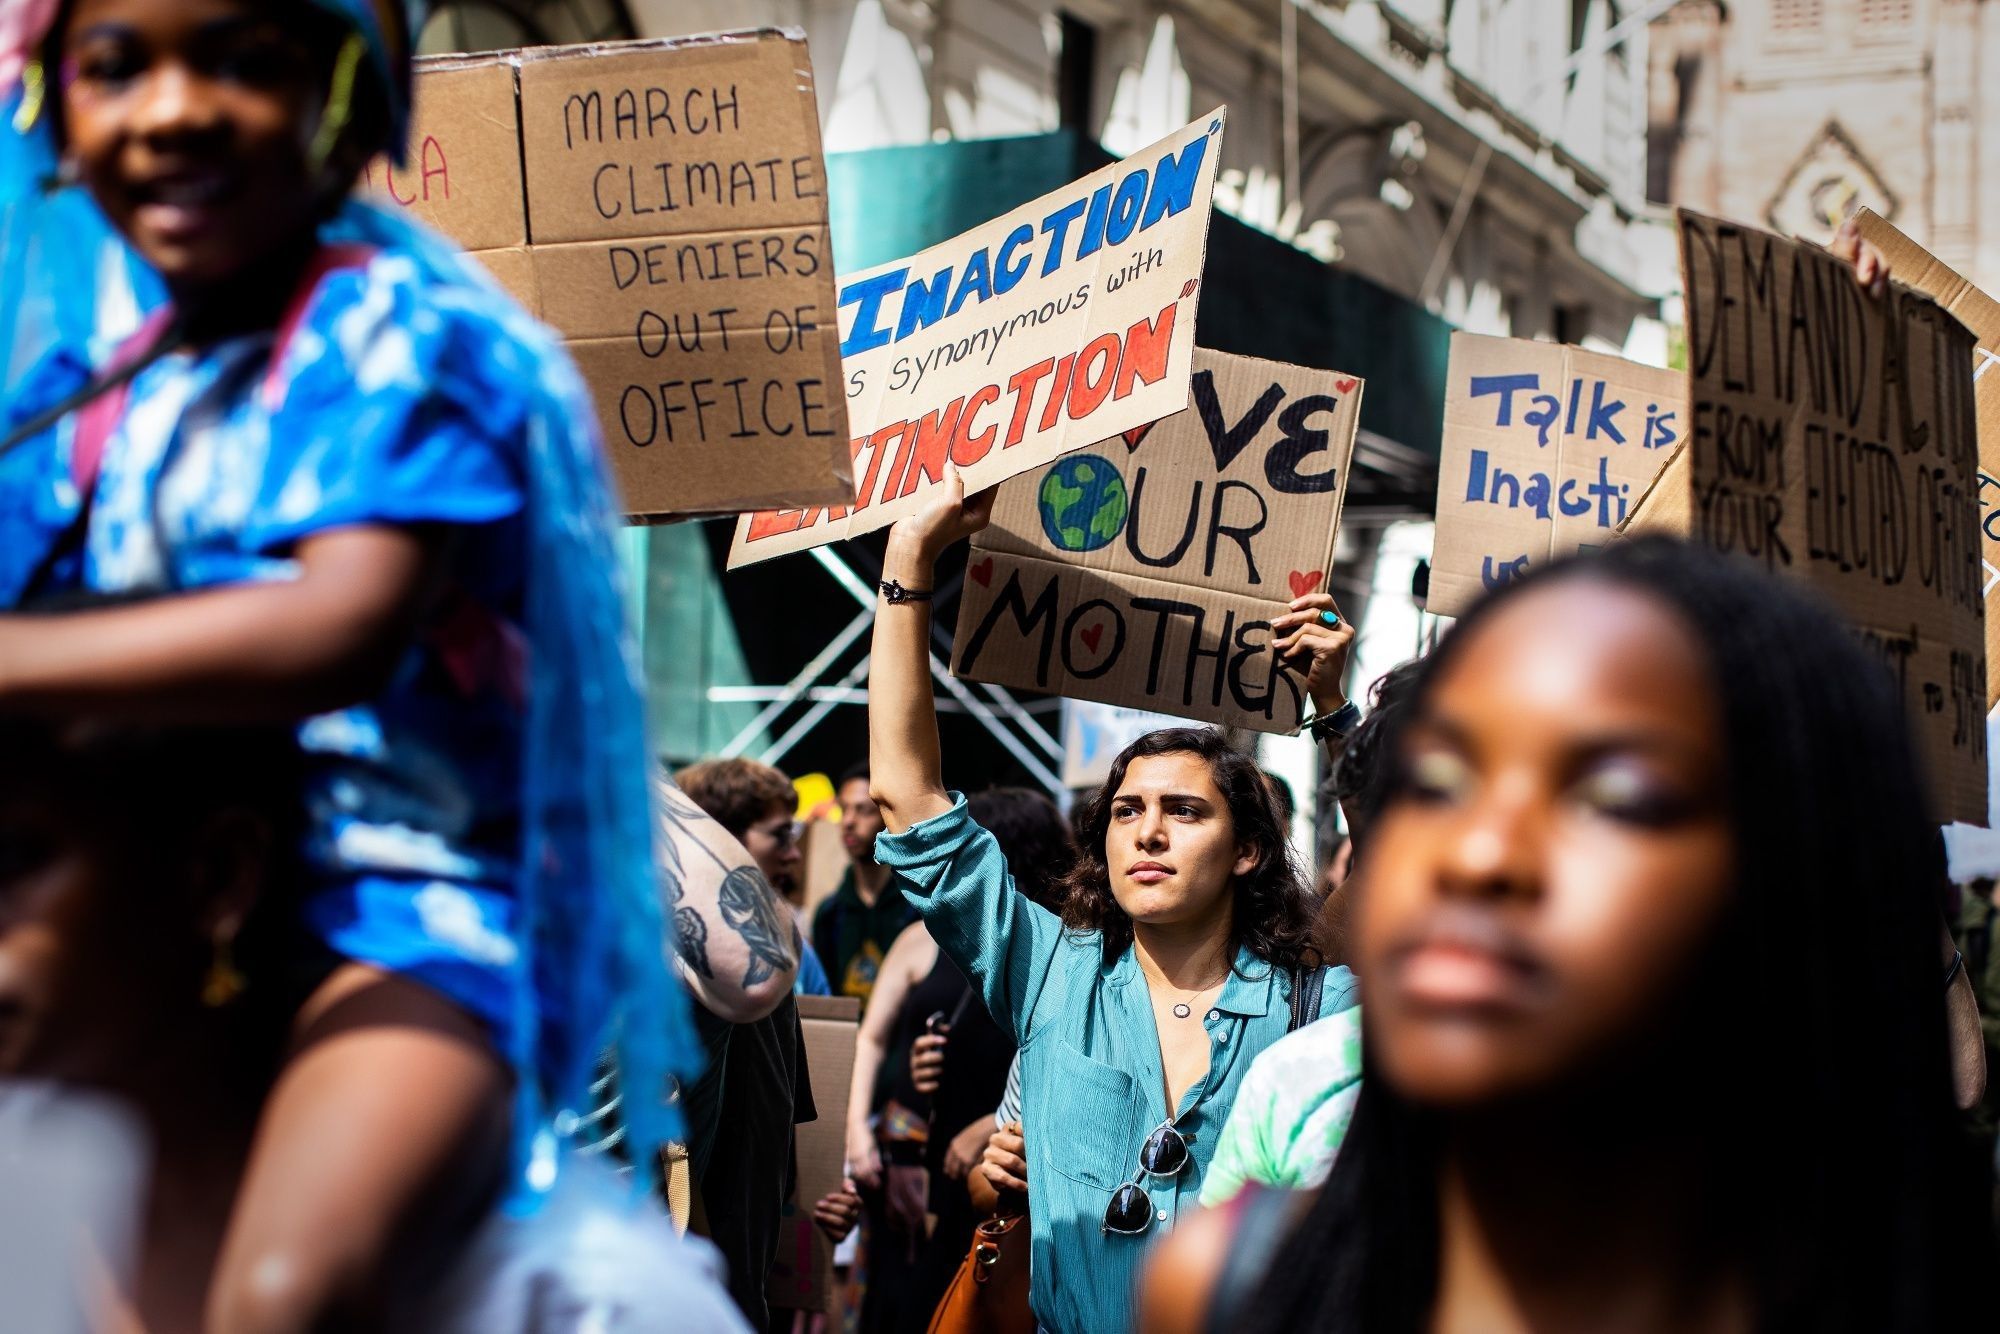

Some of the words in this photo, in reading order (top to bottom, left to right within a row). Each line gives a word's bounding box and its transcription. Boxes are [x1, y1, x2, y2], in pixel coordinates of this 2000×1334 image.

[564, 85, 740, 149] MARCH
[593, 156, 821, 219] CLIMATE
[609, 234, 820, 290] DENIERS
[1106, 246, 1164, 295] with
[636, 308, 738, 358] OUT
[764, 306, 818, 355] OF
[1682, 218, 1867, 430] DEMAND
[619, 379, 836, 447] OFFICE
[1470, 374, 1627, 448] Talk
[1643, 404, 1677, 449] is
[1694, 402, 1785, 489] FROM
[1463, 449, 1630, 528] Inacti
[1693, 477, 1792, 572] YOUR
[957, 568, 1302, 727] MOTHER
